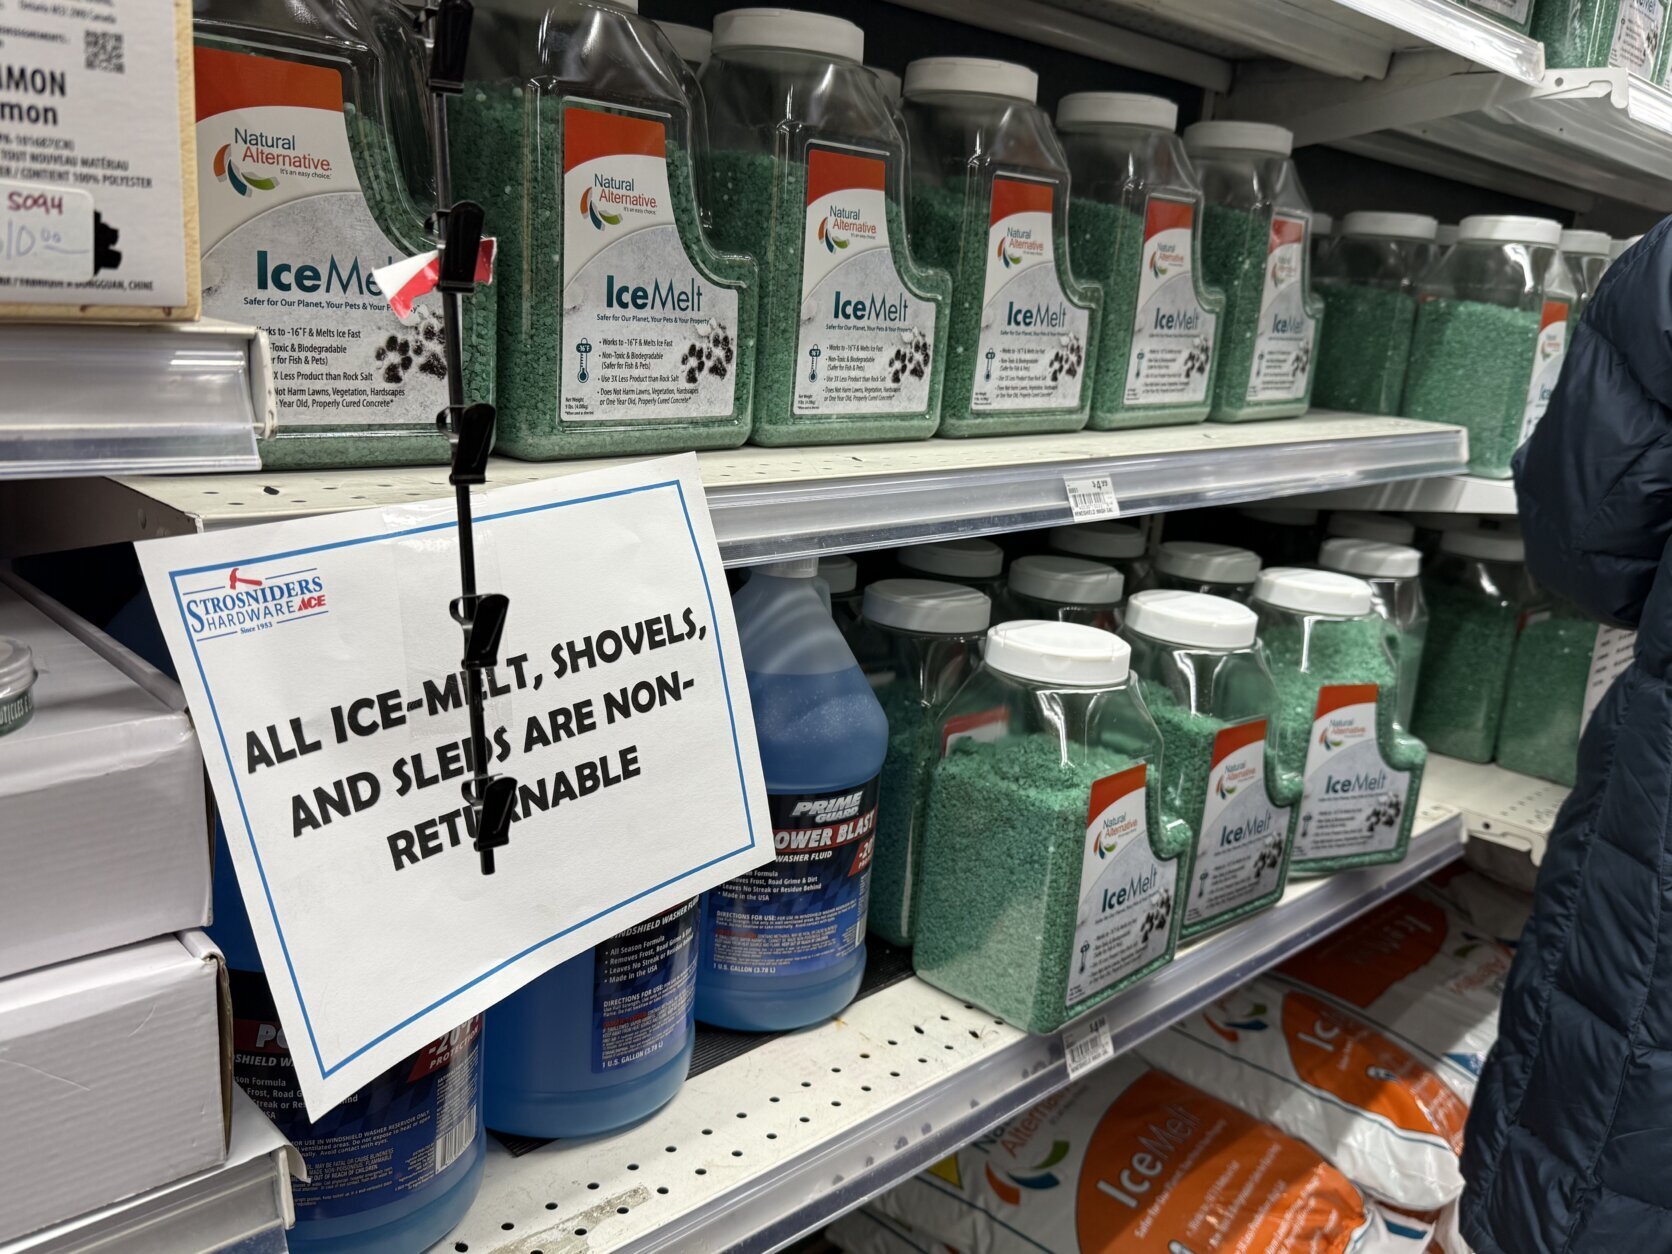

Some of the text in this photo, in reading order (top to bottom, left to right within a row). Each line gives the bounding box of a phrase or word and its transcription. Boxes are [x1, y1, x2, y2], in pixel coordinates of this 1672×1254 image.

[0, 64, 66, 97] MON
[234, 128, 295, 151] Natural
[103, 175, 152, 188] POLYESTER
[594, 173, 634, 192] Natural
[829, 205, 860, 220] Natural
[833, 219, 877, 234] Alternative
[1007, 227, 1032, 239] Natural
[1009, 238, 1044, 251] Alternative
[257, 250, 392, 296] IceMe
[606, 275, 703, 312] IceMelt
[244, 297, 265, 306] Safer
[267, 297, 278, 306] for
[281, 299, 295, 307] Our
[298, 299, 324, 309] Planet,
[325, 301, 343, 309] Your
[345, 302, 360, 310] Pets
[833, 291, 908, 322] IceMelt
[1007, 301, 1067, 328] IceMelt
[1154, 307, 1199, 331] IceMelt
[278, 328, 285, 336] to
[309, 329, 314, 337] &
[316, 329, 335, 338] Melts
[337, 330, 346, 338] Ice
[348, 330, 361, 338] Fast
[291, 344, 296, 352] &
[298, 344, 347, 355] Biodegradable
[603, 338, 617, 346] Works
[277, 356, 286, 364] for
[289, 356, 302, 364] Fish
[311, 357, 328, 366] Pets)
[631, 352, 663, 361] Biodegradable
[281, 372, 373, 380] Less Product than Rock Salt
[288, 388, 306, 396] Harm
[308, 388, 330, 397] Lawns,
[332, 388, 368, 398] Vegetation,
[370, 388, 405, 398] Hardscapes
[652, 388, 675, 396] Vegetation,
[279, 400, 294, 408] Year
[296, 400, 310, 409] Old,
[312, 400, 340, 409] Properly
[342, 400, 360, 408] Cured
[186, 576, 324, 634] STROSNIDERS
[206, 594, 326, 632] HARDWARE ACE
[240, 622, 272, 634] Since 1953
[246, 717, 322, 774] ALL
[551, 607, 707, 680] SHOVELS,
[1329, 719, 1354, 727] Natural
[1331, 726, 1366, 735] Alternative
[291, 771, 381, 838] AND
[523, 699, 596, 754] ARE
[603, 670, 695, 725] NON-
[1225, 761, 1247, 774] Natural
[1226, 767, 1256, 781] Alternative
[1325, 771, 1387, 794] IceMelt
[791, 791, 863, 816] PRIME
[1103, 812, 1127, 829] Natural
[1105, 819, 1138, 838] Alternative
[1220, 810, 1272, 847] IceMelt
[774, 812, 875, 849] OWER BLAST
[775, 851, 833, 862] WASHER FLUID
[803, 883, 821, 891] Behind
[1101, 863, 1158, 913] IceMelt
[662, 906, 687, 925] WASHER
[717, 910, 749, 920] DIRECTIONS
[621, 944, 642, 954] Season
[643, 936, 665, 948] Formula
[610, 944, 668, 964] Removes Frost, Road
[609, 974, 627, 983] Made
[636, 969, 646, 977] the
[647, 965, 657, 973] USA
[604, 985, 663, 1007] DIRECTIONS FOR USE:
[430, 1024, 478, 1069] PROTECTION
[252, 1077, 286, 1086] Formula
[247, 1088, 294, 1098] Frost, Road
[326, 1132, 362, 1144] WINDSHIELD
[364, 1128, 387, 1137] WASHER
[389, 1117, 416, 1130] RESERVOIR
[1097, 1103, 1201, 1208] IceMelt
